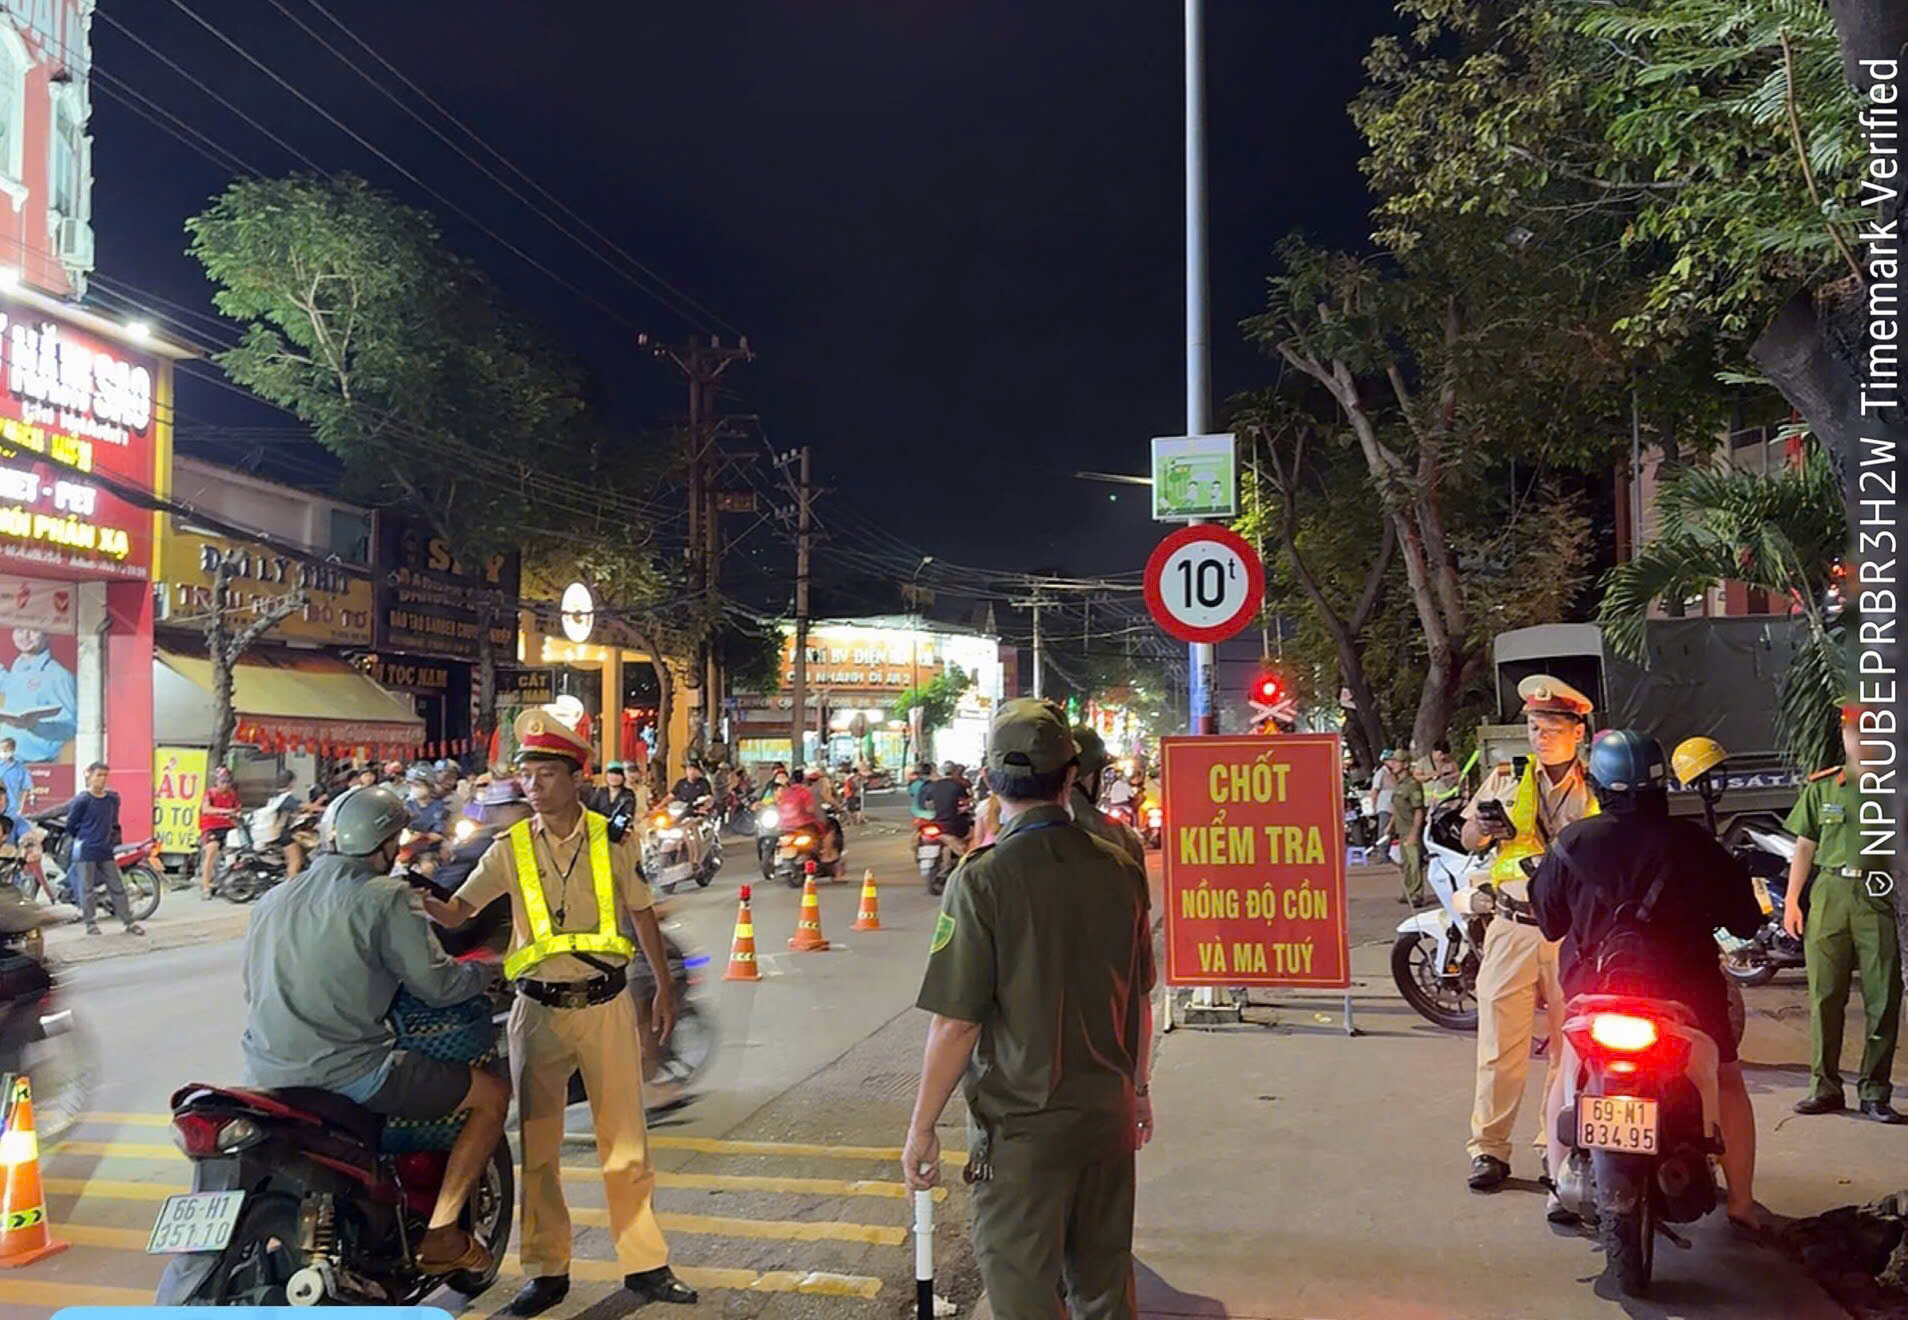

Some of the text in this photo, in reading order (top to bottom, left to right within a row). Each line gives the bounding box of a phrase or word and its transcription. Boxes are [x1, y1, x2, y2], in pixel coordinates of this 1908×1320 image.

[1209, 750, 1291, 804] CHỐT
[1179, 808, 1326, 865] KIỂM TRA
[1181, 878, 1328, 926] NỒNG ĐỘ CỒN
[1198, 935, 1314, 974] VÀ MA TUÝ
[1584, 1122, 1654, 1149] 834.95
